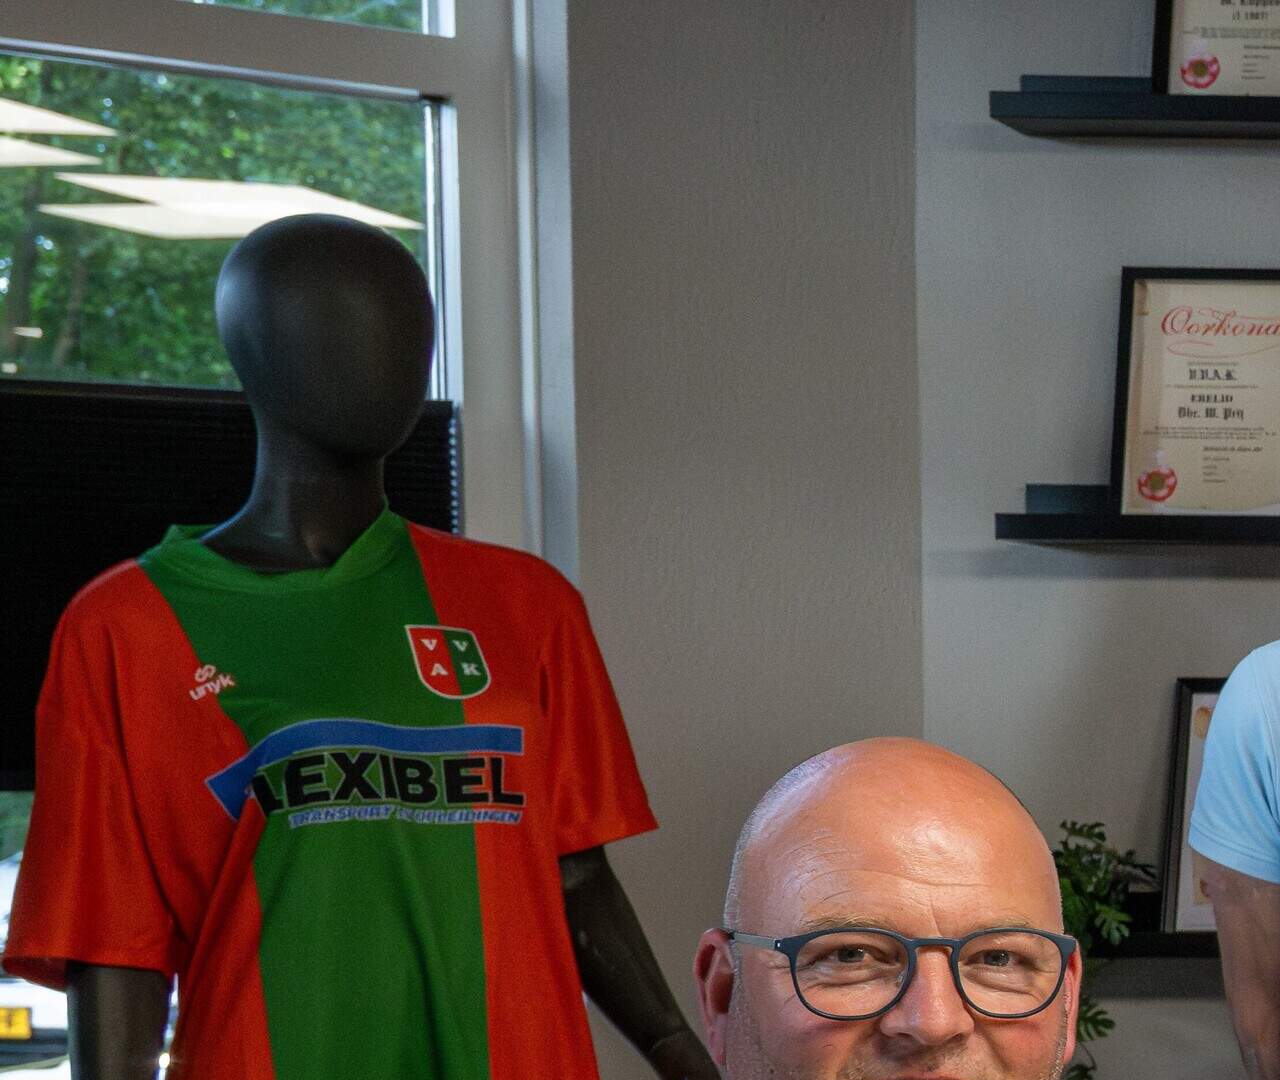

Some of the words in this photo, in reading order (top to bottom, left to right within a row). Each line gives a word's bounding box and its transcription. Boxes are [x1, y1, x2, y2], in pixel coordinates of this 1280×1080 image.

[421, 639, 437, 651] V
[453, 640, 468, 652] V
[431, 663, 449, 676] A
[461, 662, 482, 676] K
[248, 752, 525, 817] LEXIBEL
[289, 805, 394, 828] TRANSPORT
